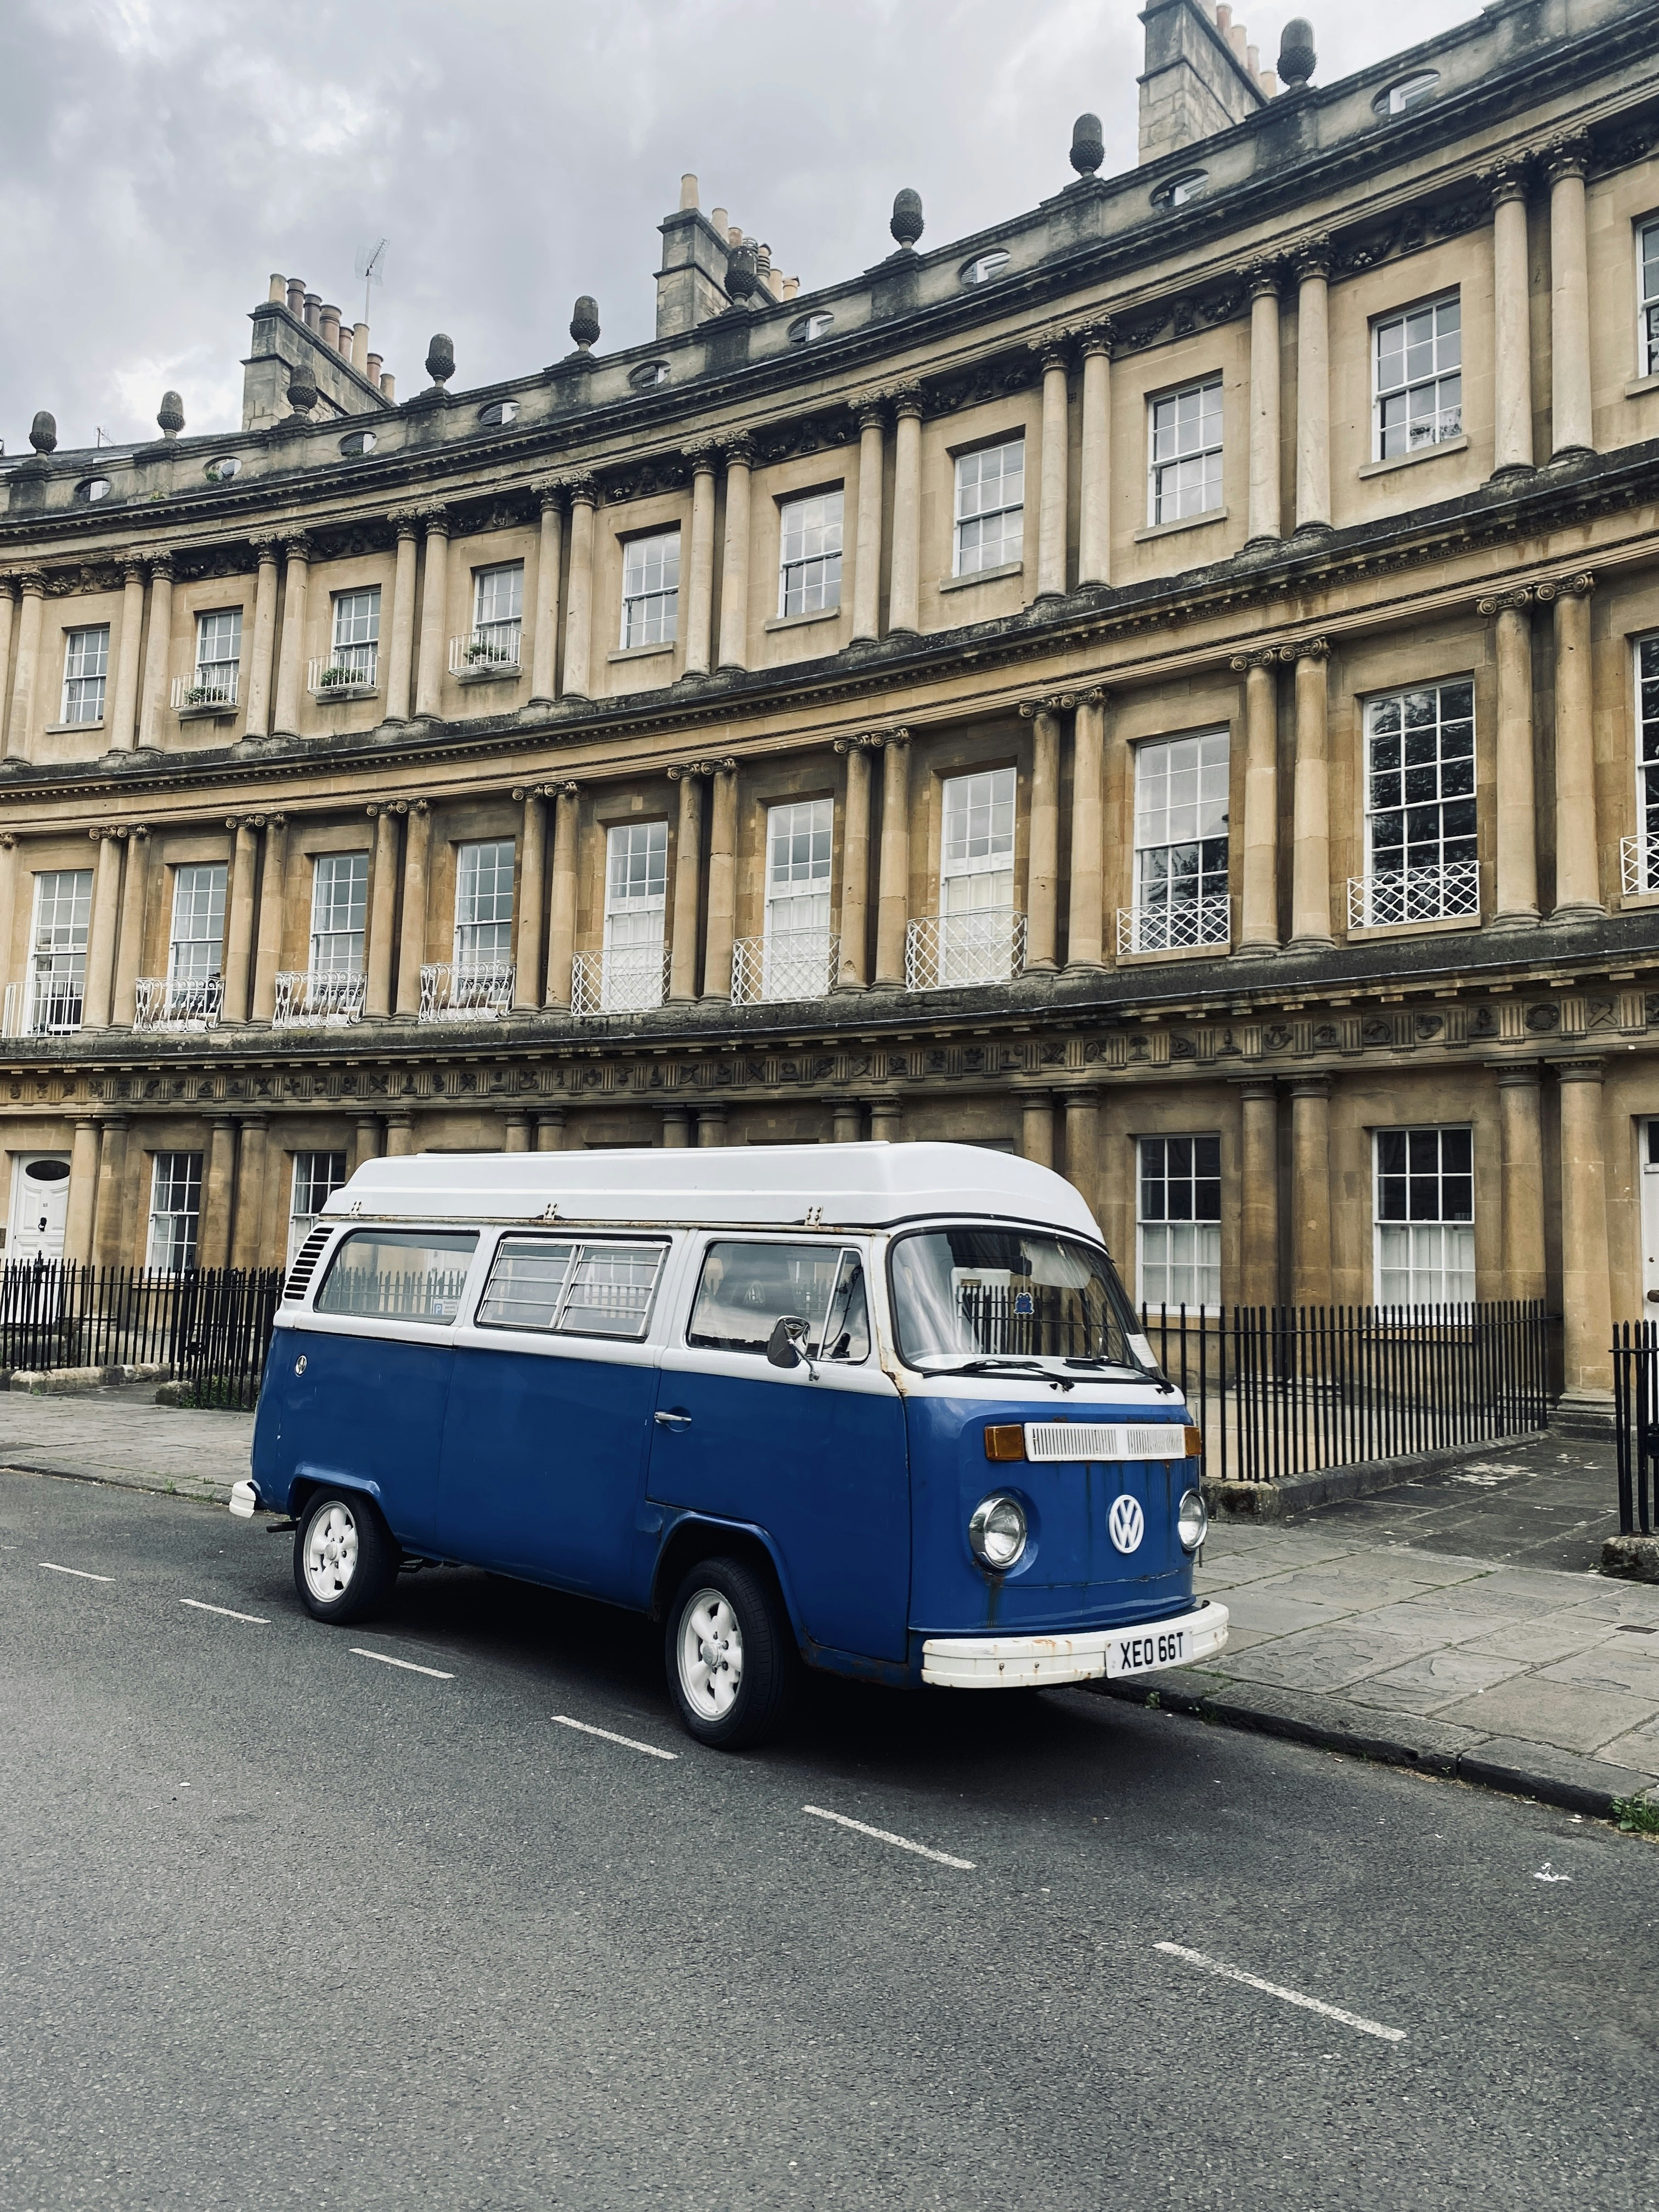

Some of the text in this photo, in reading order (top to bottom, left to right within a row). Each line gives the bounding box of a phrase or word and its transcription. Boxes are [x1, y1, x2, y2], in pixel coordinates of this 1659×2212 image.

[1111, 1498, 1143, 1550] VW
[1120, 1632, 1183, 1670] XEO 66T
